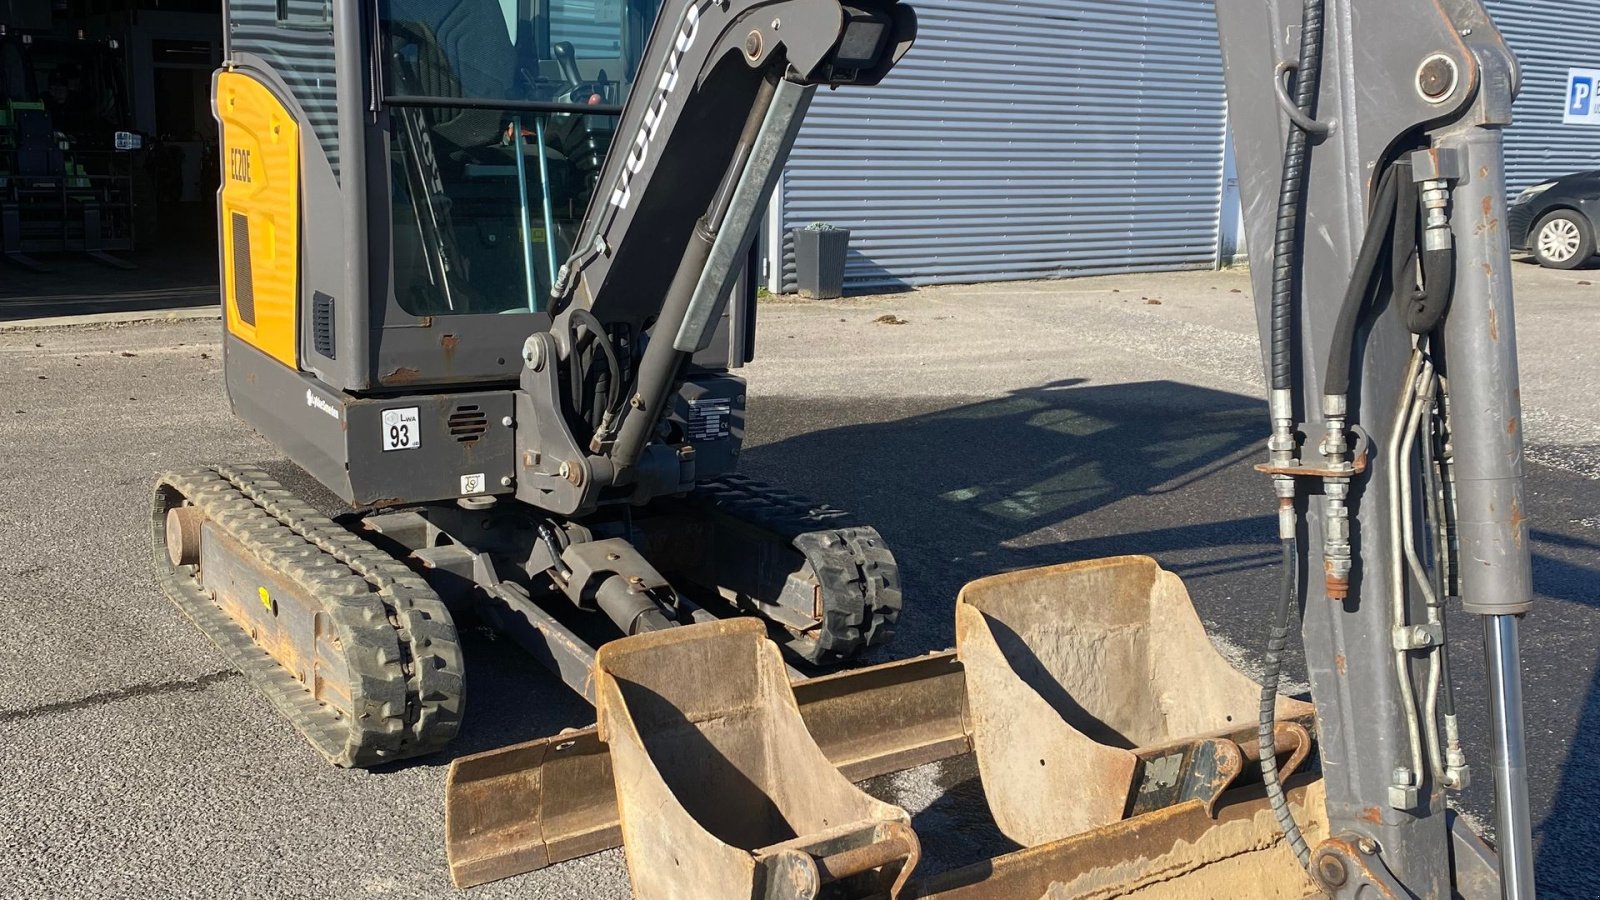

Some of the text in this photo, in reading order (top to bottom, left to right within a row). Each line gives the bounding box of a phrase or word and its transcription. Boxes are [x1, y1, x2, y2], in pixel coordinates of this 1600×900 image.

[610, 3, 699, 209] VOLVO
[1573, 82, 1590, 108] P
[231, 148, 251, 183] EC20E
[390, 424, 409, 448] 93
